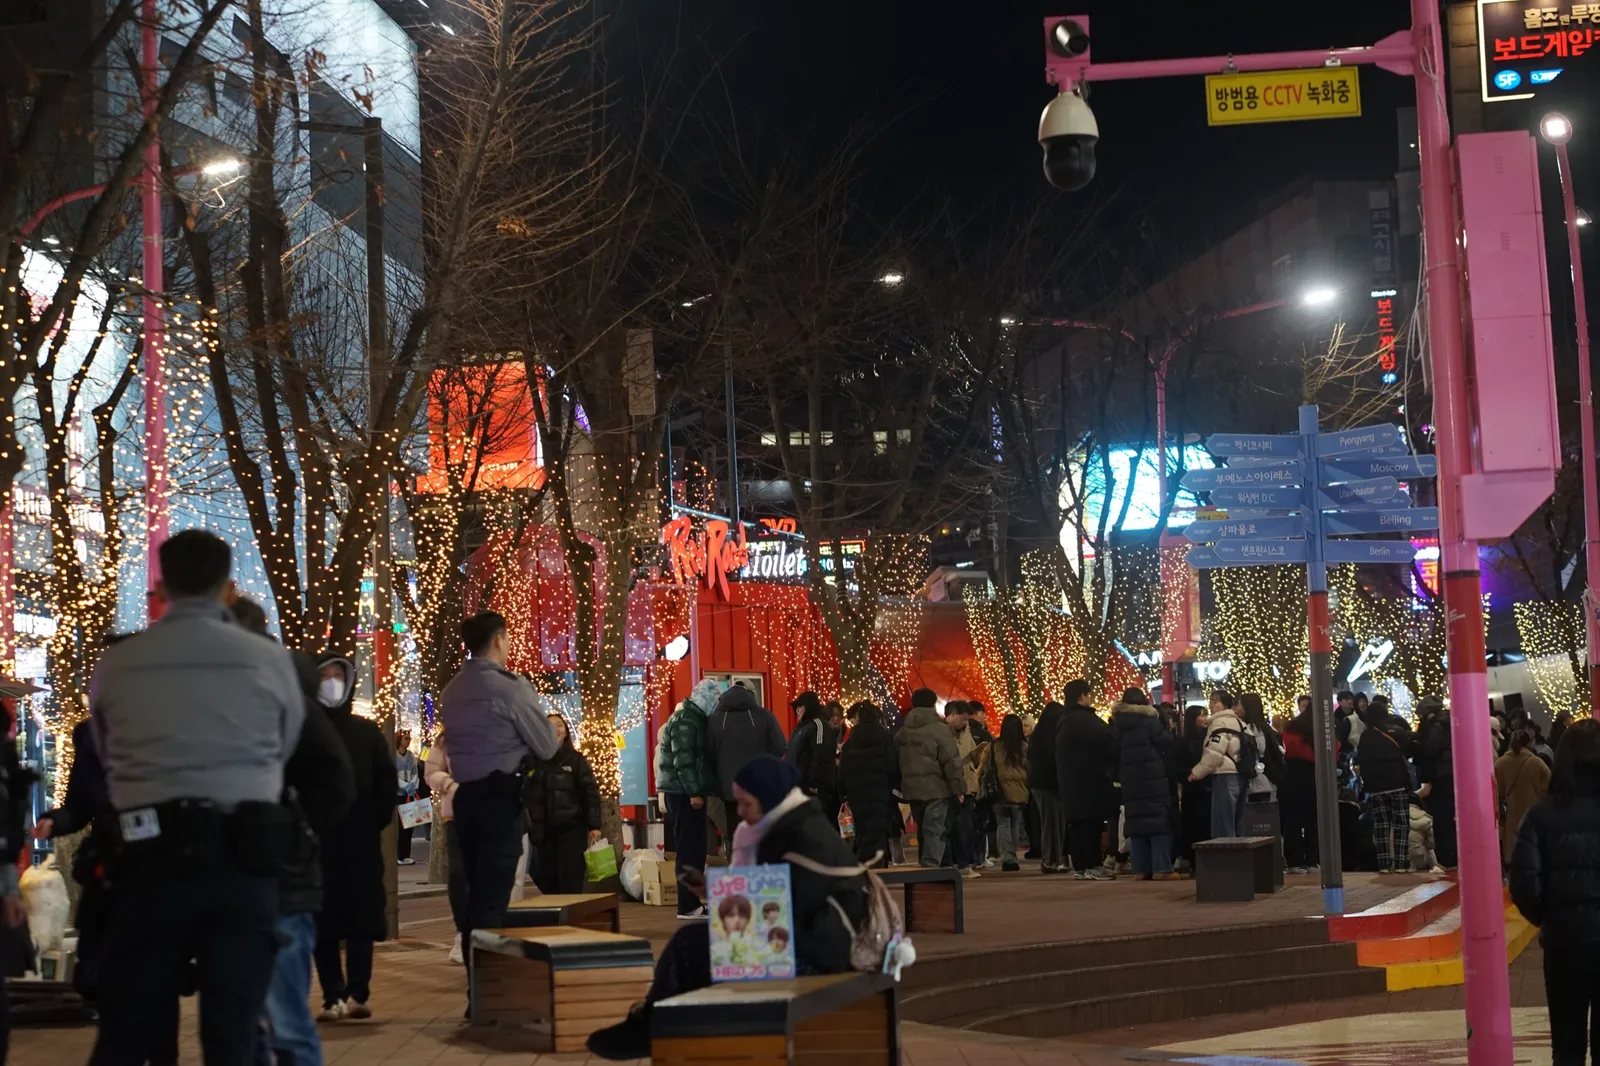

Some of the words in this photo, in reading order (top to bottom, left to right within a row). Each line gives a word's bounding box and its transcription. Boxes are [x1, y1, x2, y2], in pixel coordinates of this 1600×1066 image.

[1493, 28, 1600, 61] 보드게임
[1498, 72, 1517, 87] 5F
[1215, 86, 1259, 112] 방범용
[1263, 84, 1303, 107] CCTV
[1306, 80, 1351, 105] 녹화중
[1234, 440, 1273, 452] 멕시코시티
[1340, 433, 1375, 448] Pyongyang
[1370, 463, 1409, 474] Moscow
[1215, 470, 1293, 485] 부에노스아이레스
[1238, 492, 1260, 505] 워싱턴
[1261, 493, 1277, 504] D.C.
[1379, 514, 1412, 526] Beijing
[1218, 523, 1257, 537] 상파울로
[1369, 546, 1391, 556] Berlin
